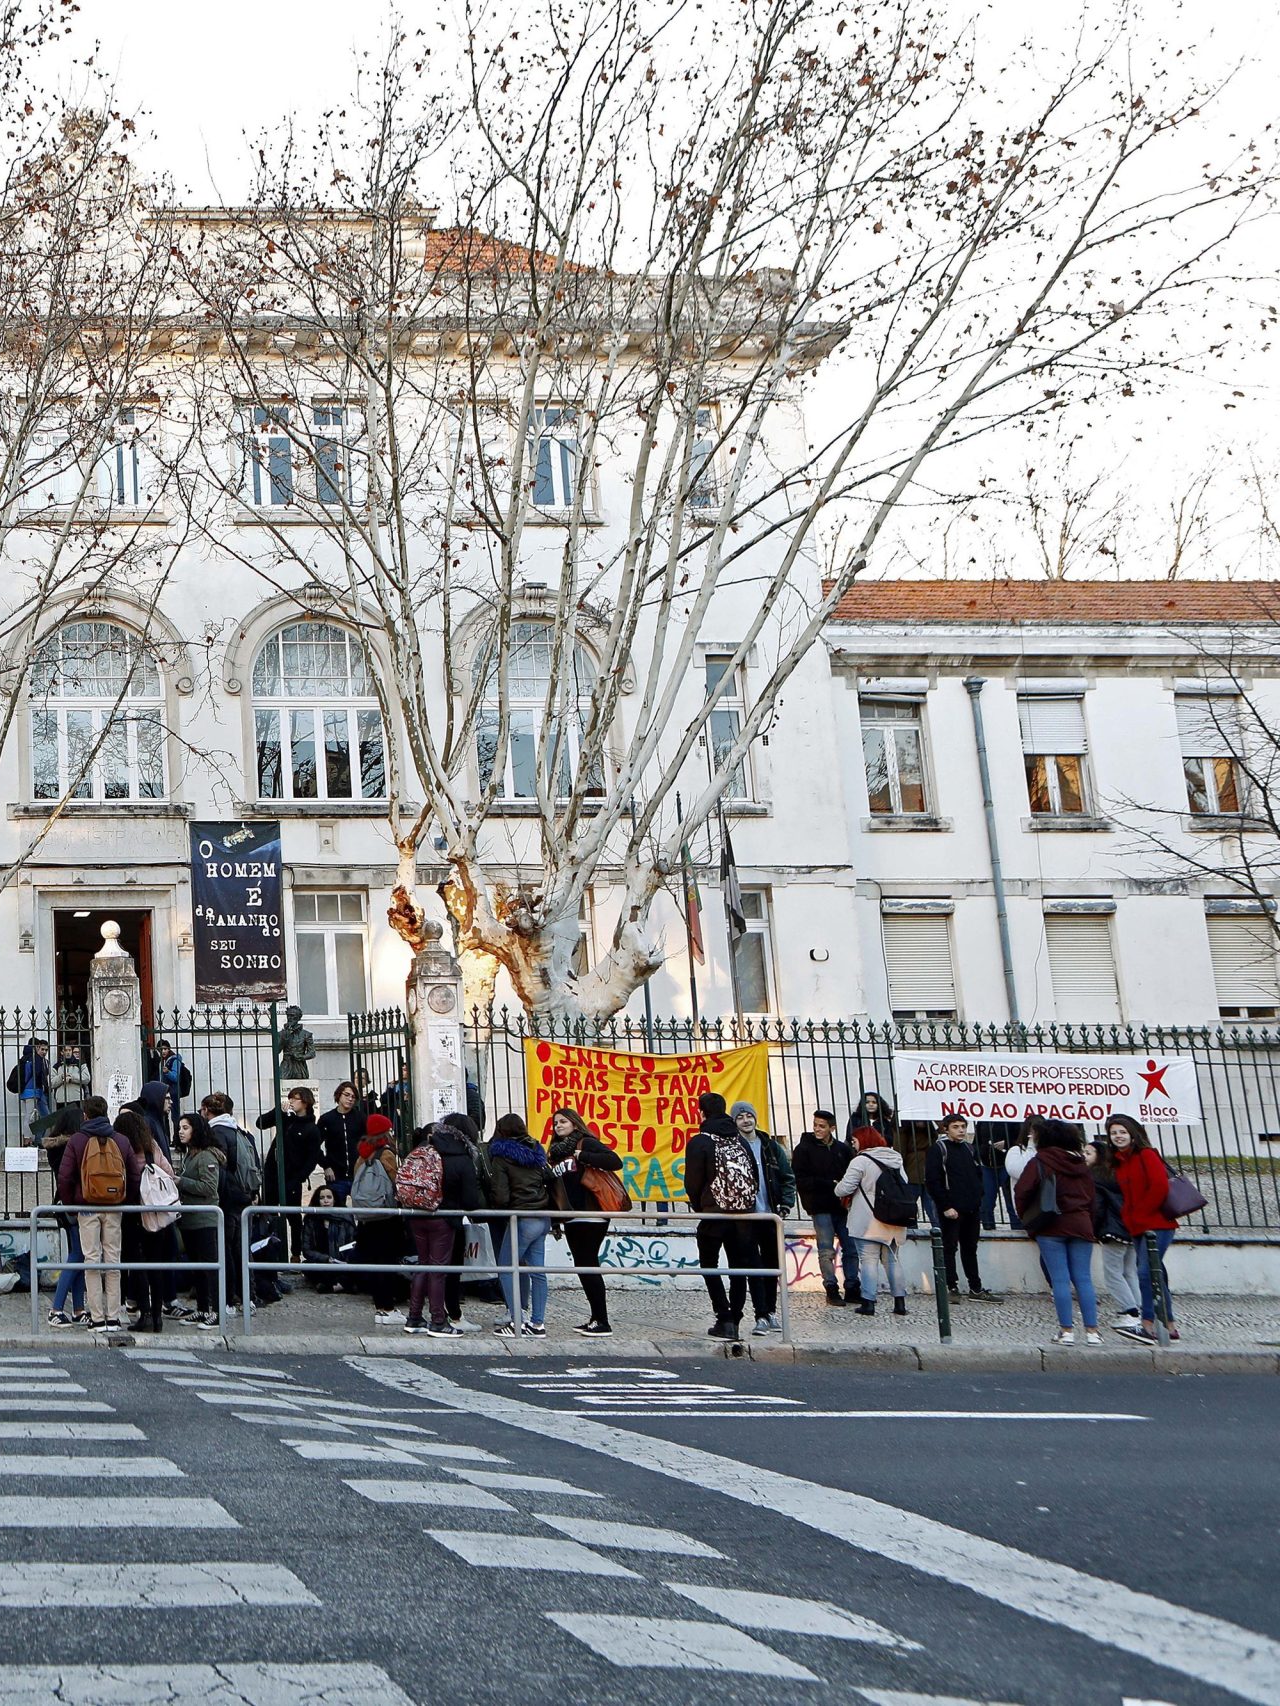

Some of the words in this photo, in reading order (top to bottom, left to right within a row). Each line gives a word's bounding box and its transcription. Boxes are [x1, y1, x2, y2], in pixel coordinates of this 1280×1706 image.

[199, 840, 214, 859] O
[206, 862, 277, 878] HOMEM
[246, 880, 263, 907] É
[195, 904, 214, 917] do
[206, 914, 279, 927] TAMANHO
[262, 925, 281, 937] do
[210, 939, 237, 951] SEU
[220, 954, 282, 969] SONHO
[536, 1041, 552, 1063] O
[676, 1053, 725, 1074] DAS
[917, 1063, 928, 1076] A
[930, 1063, 998, 1077] CARREIRA
[1000, 1065, 1030, 1078] DOS
[1032, 1066, 1124, 1080] PROFESSORES
[542, 1065, 610, 1092] OBRAS
[623, 1073, 712, 1096] ESTAVA
[913, 1076, 946, 1092] NÃO
[949, 1079, 987, 1093] PODE
[989, 1081, 1015, 1094] SER
[1016, 1082, 1066, 1095] TEMPO
[1069, 1082, 1131, 1097] PERDIDO
[536, 1088, 642, 1123] PREVISTO
[656, 1096, 702, 1125] PAR
[940, 1098, 985, 1118] NÃO
[989, 1102, 1018, 1119] AO
[1023, 1101, 1113, 1121] APAGÃO!
[1139, 1103, 1178, 1117] Bloco
[1150, 1116, 1179, 1124] Esquerda
[540, 1116, 657, 1154] AOSTO
